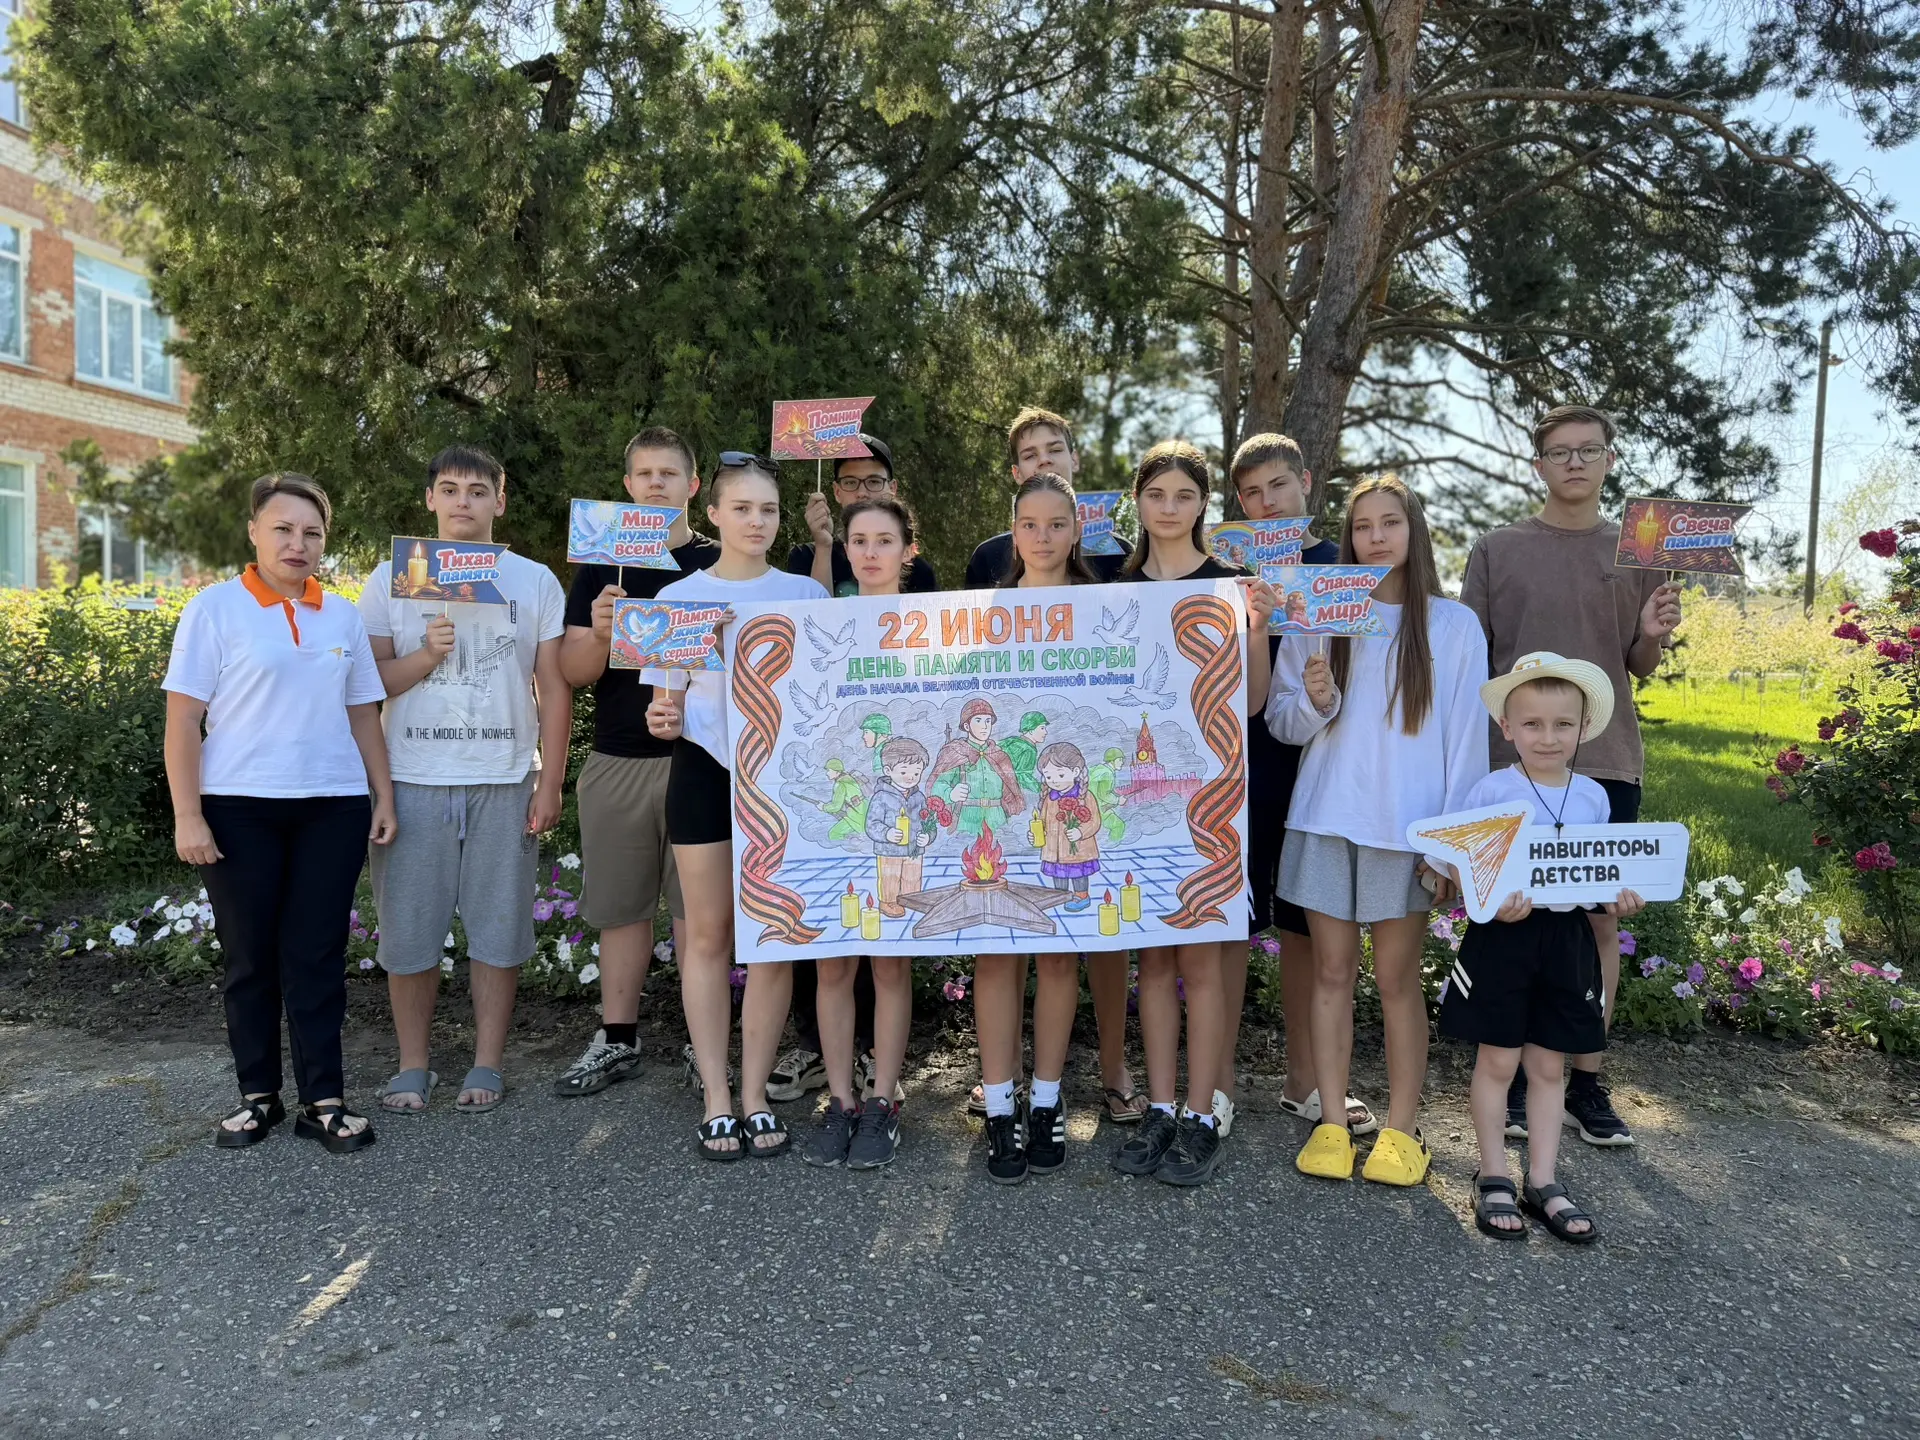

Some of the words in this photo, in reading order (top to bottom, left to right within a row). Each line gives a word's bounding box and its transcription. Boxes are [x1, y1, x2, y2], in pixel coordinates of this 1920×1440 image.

[808, 409, 861, 429] Помним
[815, 421, 861, 441] героев!
[621, 511, 664, 529] Мир
[1083, 520, 1113, 536] ним
[1668, 514, 1731, 534] Свеча
[617, 530, 669, 543] нужен
[1253, 526, 1301, 546] Пусть
[1665, 534, 1734, 549] памяти
[614, 541, 662, 556] всем!
[1255, 540, 1302, 560] будет
[436, 549, 496, 569] Тихая
[439, 568, 500, 583] память
[1312, 573, 1377, 595] Спасибо
[1333, 590, 1354, 603] за
[670, 609, 722, 627] Память
[1315, 598, 1371, 623] мир!
[672, 622, 714, 638] живёт
[878, 610, 929, 649] 22
[941, 603, 1073, 646] ИЮНЯ
[686, 638, 694, 646] в
[664, 646, 709, 661] сердцах
[846, 656, 907, 681] ДЕНЬ
[914, 650, 1011, 676] ПАМЯТИ
[1018, 649, 1035, 672] И
[1041, 646, 1136, 671] СКОРБИ
[836, 684, 868, 698] ДЕНЬ
[870, 681, 920, 695] НАЧАЛА
[923, 677, 979, 692] ВЕЛИКОЙ
[982, 673, 1086, 689] ОТЕЧЕСТВЕННОЙ
[1089, 672, 1135, 686] ВОЙНЫ
[415, 727, 430, 740] THE
[433, 727, 464, 740] MIDDLE
[467, 728, 478, 740] OF
[482, 728, 516, 740] NOWHER
[1529, 839, 1660, 860] НАВИГАТОРЫ
[1530, 864, 1620, 887] ДЕТСТВА
[709, 1116, 737, 1136] TY
[750, 1113, 776, 1131] TY
